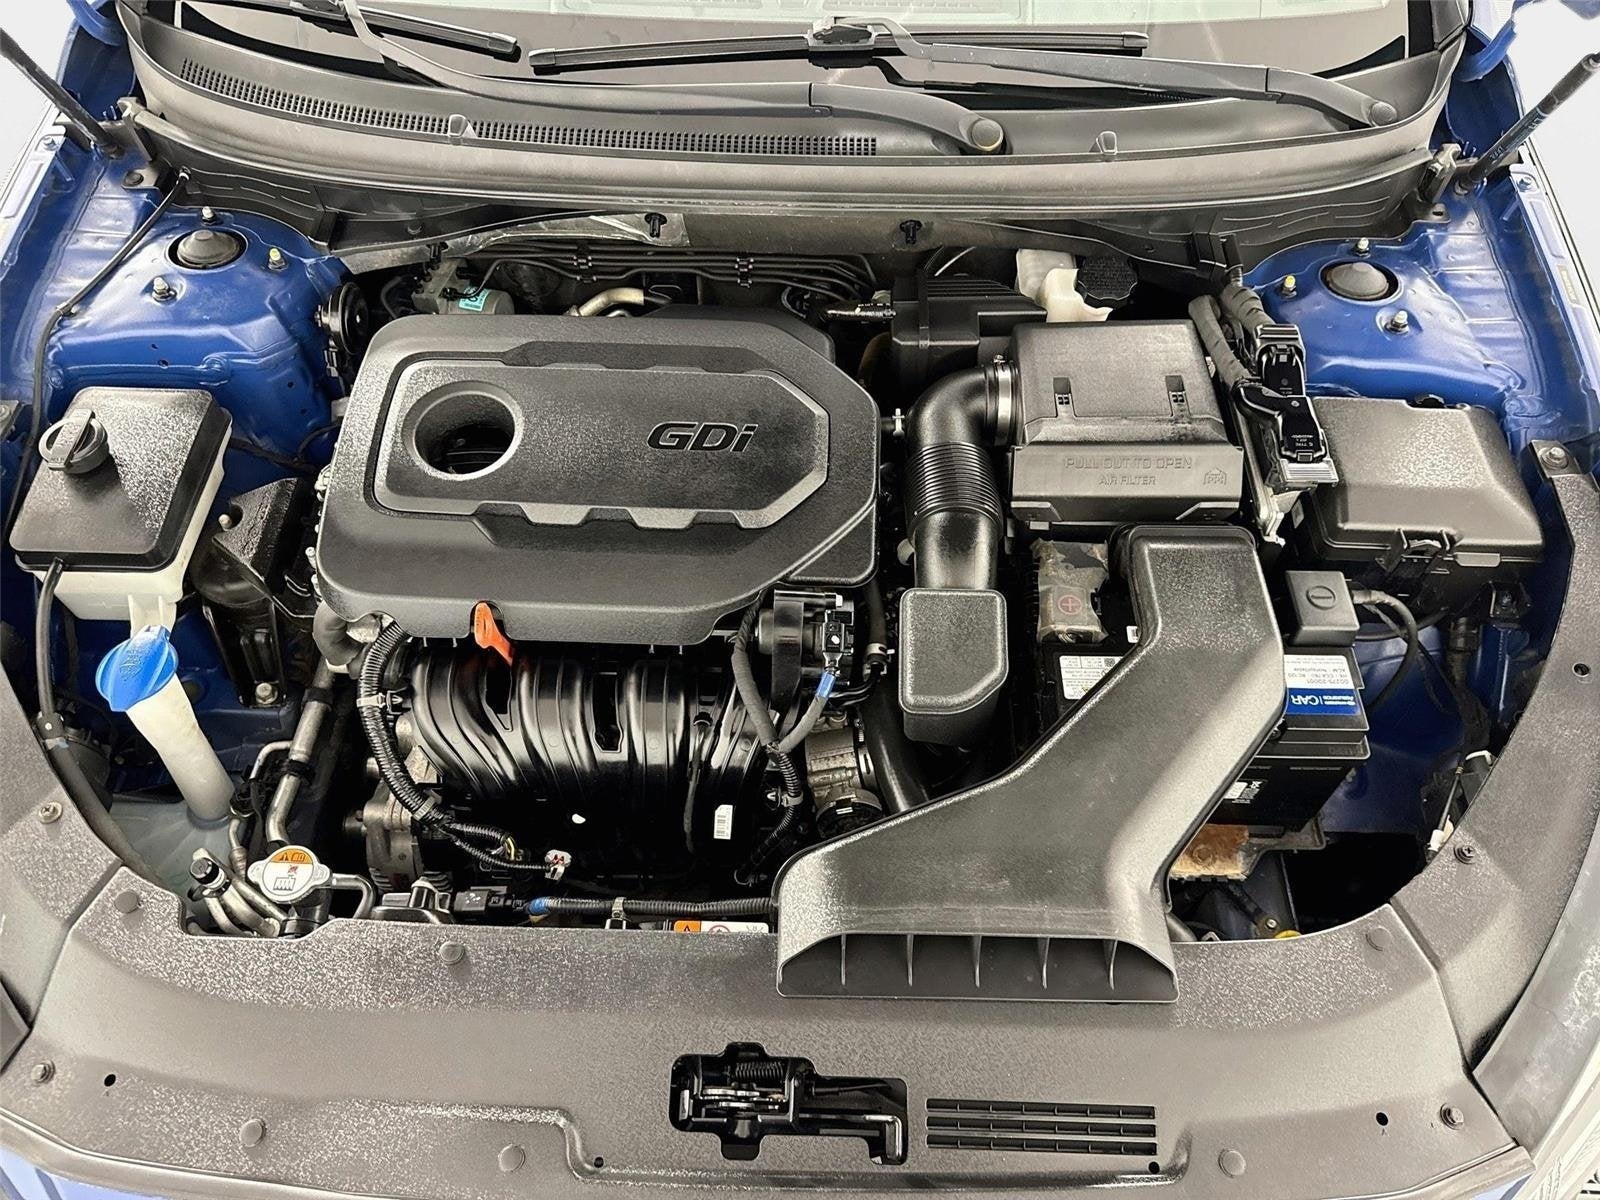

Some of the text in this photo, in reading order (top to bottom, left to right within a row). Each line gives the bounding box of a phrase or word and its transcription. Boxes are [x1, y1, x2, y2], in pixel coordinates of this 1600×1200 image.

[647, 421, 759, 452] GDi
[1064, 456, 1193, 469] PULL OUT TO OPEN
[1099, 475, 1157, 486] AIR FILTER
[1290, 695, 1319, 705] CAR
